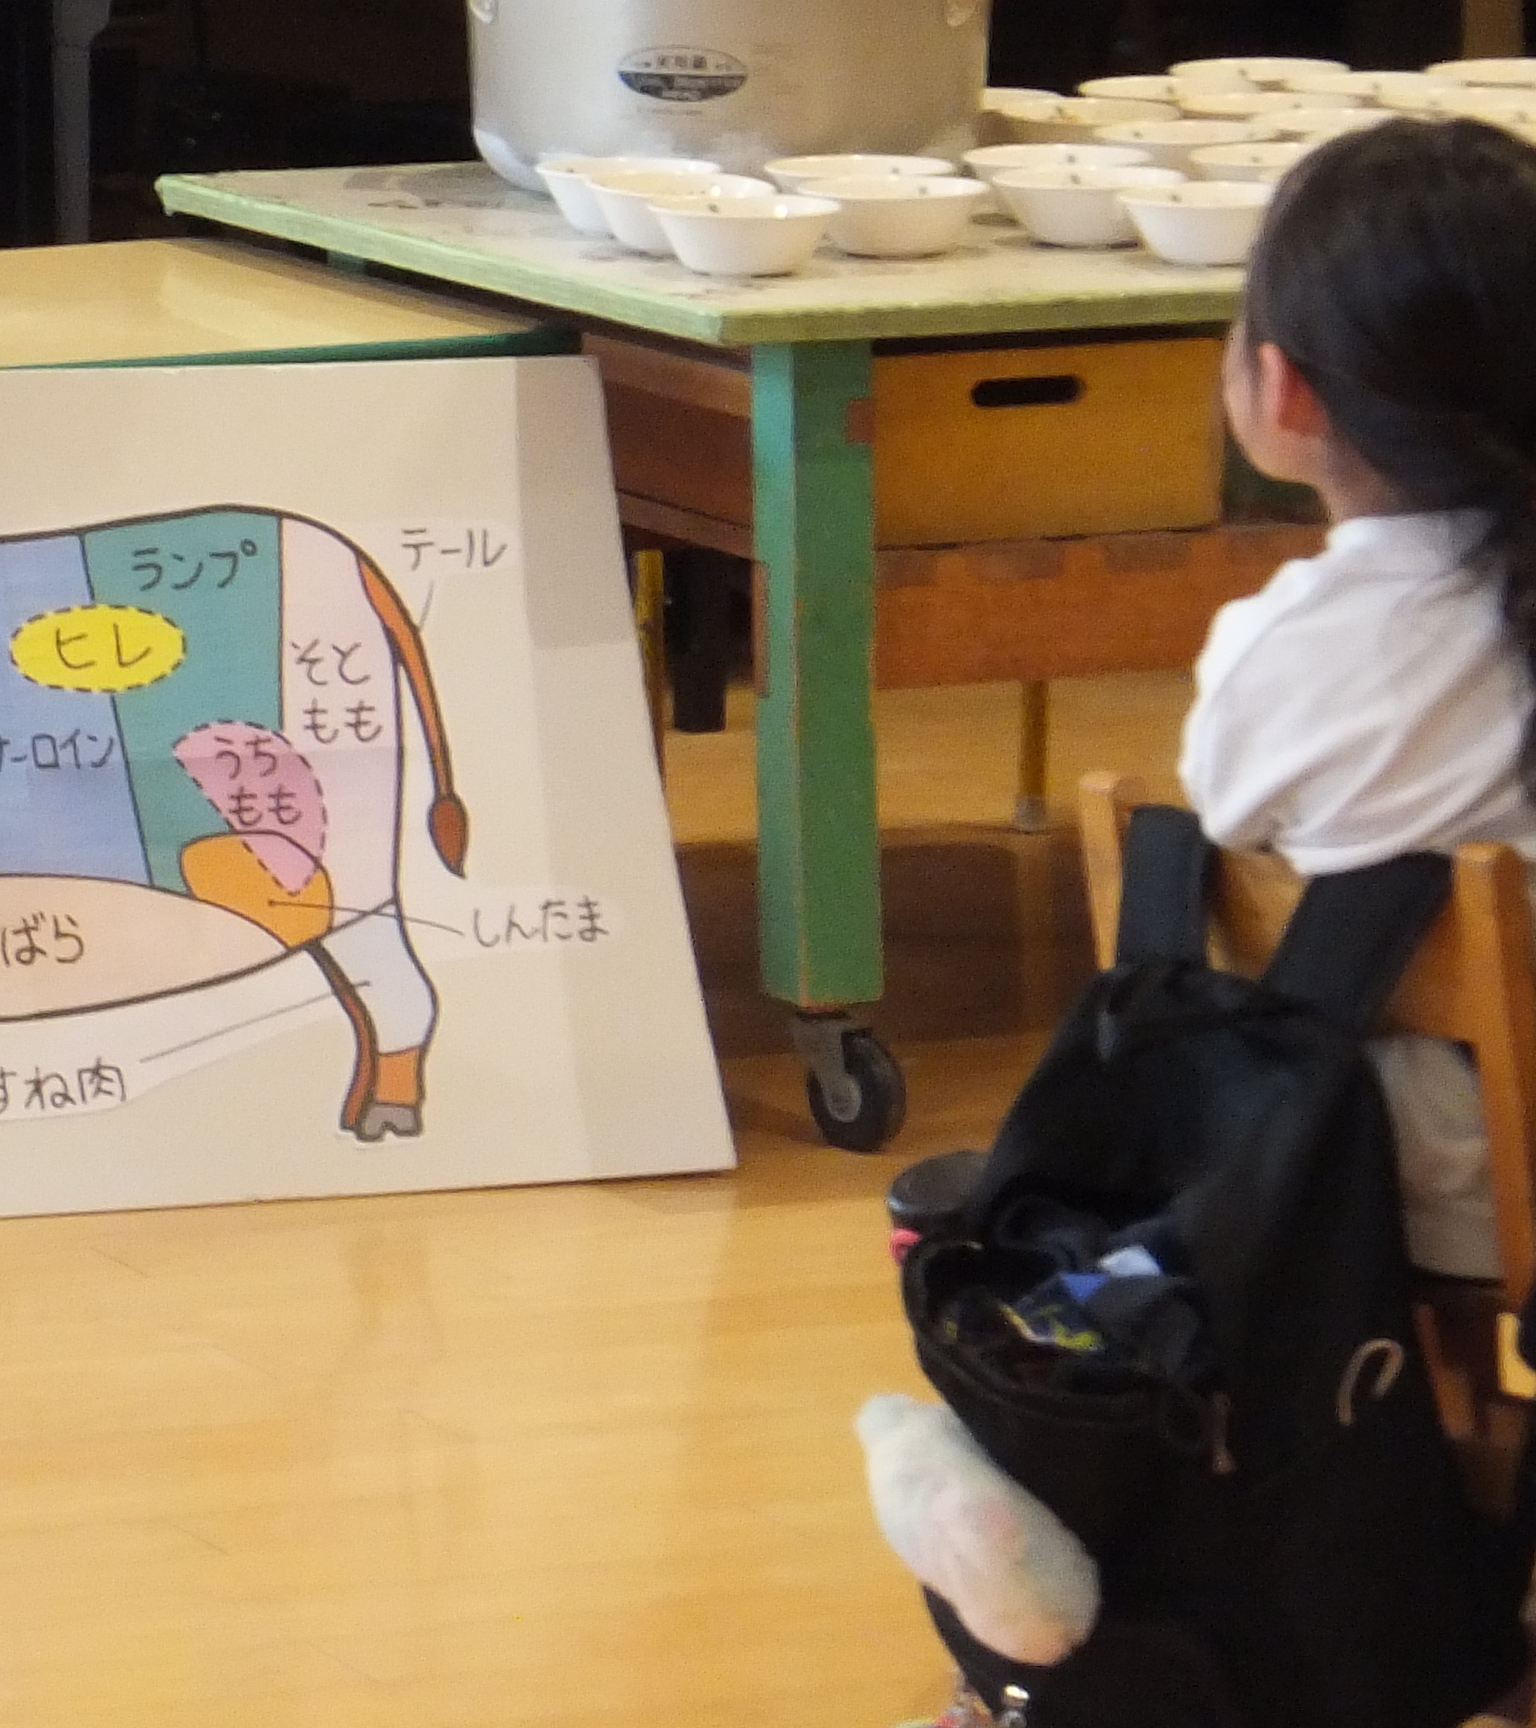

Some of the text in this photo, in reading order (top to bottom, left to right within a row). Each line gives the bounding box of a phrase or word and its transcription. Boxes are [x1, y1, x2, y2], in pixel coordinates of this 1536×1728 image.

[131, 538, 259, 593] ランプ
[401, 527, 508, 572] テール
[54, 622, 153, 670] ヒレ
[290, 637, 372, 686] そと
[303, 697, 383, 745] もも
[214, 734, 278, 780] うち
[229, 785, 302, 827] もも
[473, 895, 610, 949] しんたま
